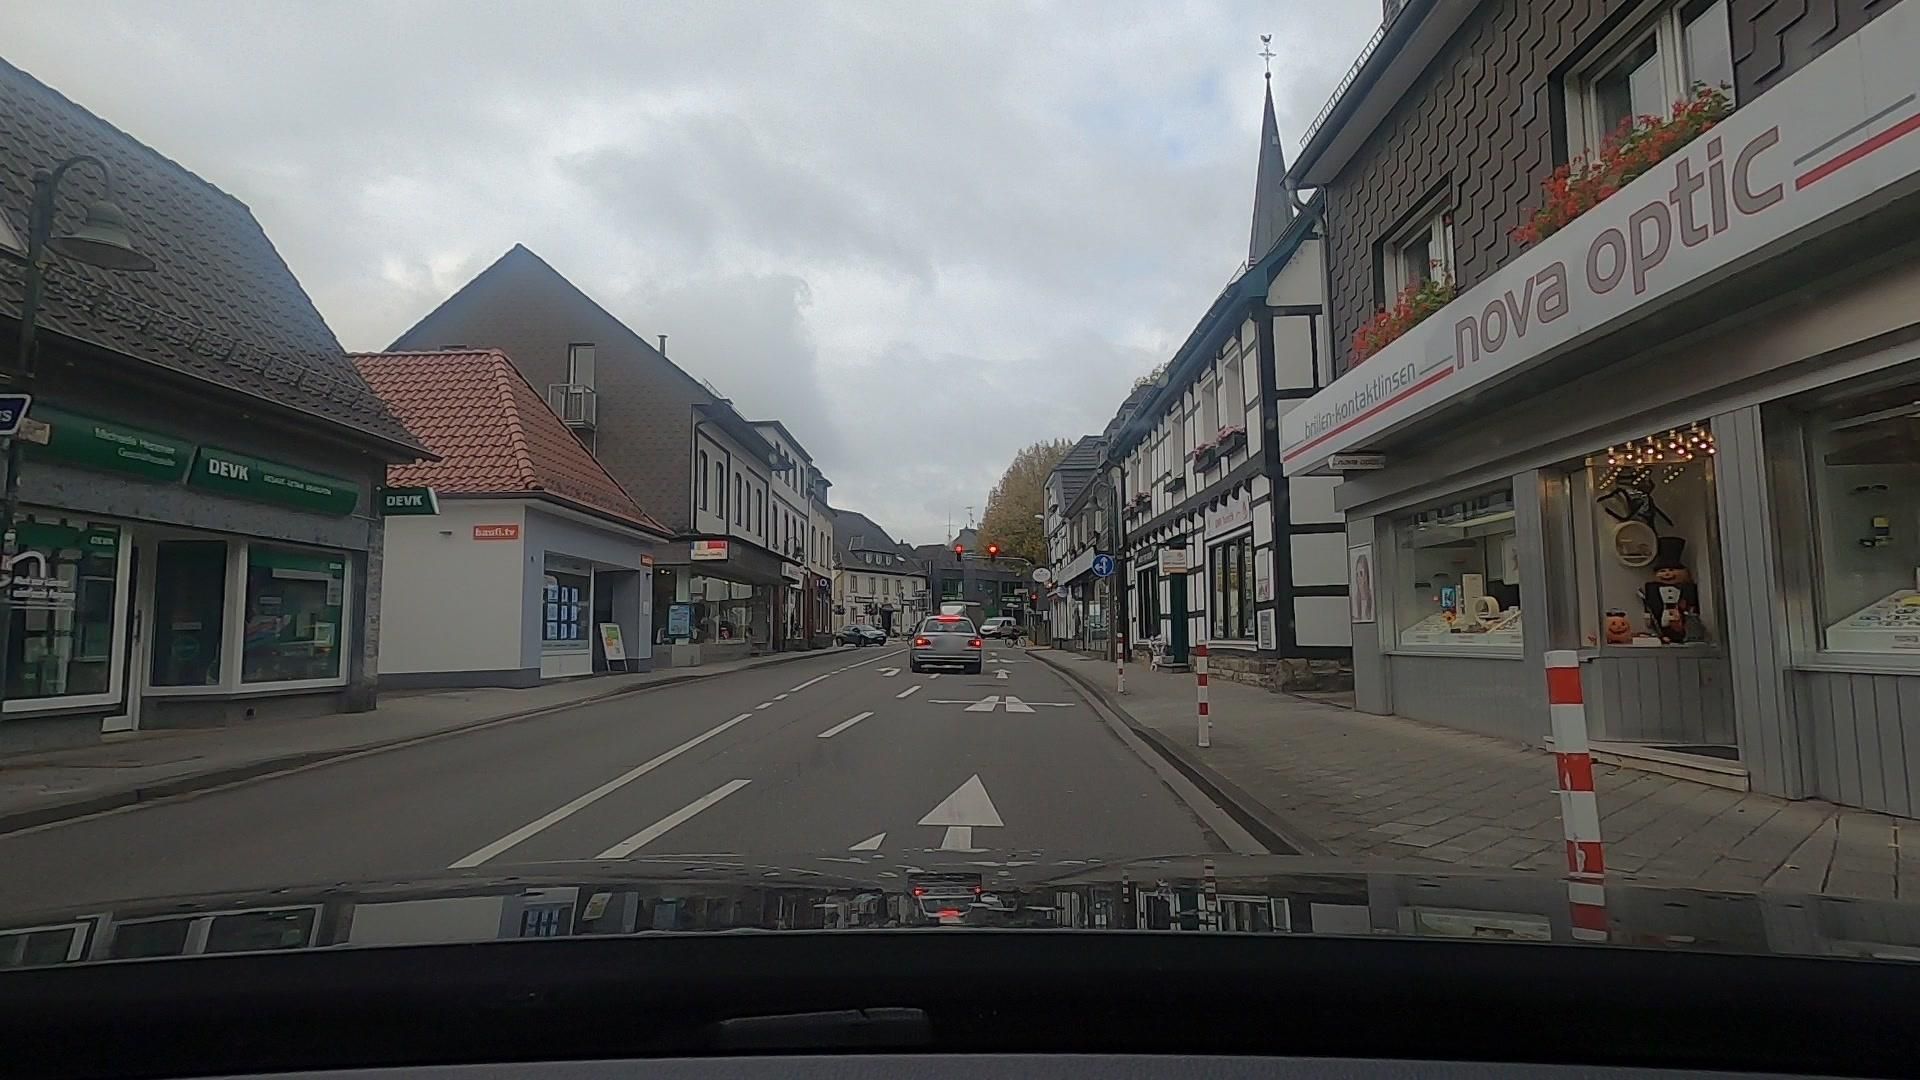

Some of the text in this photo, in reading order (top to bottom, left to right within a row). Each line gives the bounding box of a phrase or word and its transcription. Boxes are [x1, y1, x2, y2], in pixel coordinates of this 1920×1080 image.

[1455, 125, 1784, 369] nova optic
[208, 458, 249, 481] DEVK
[386, 494, 423, 507] DEVK
